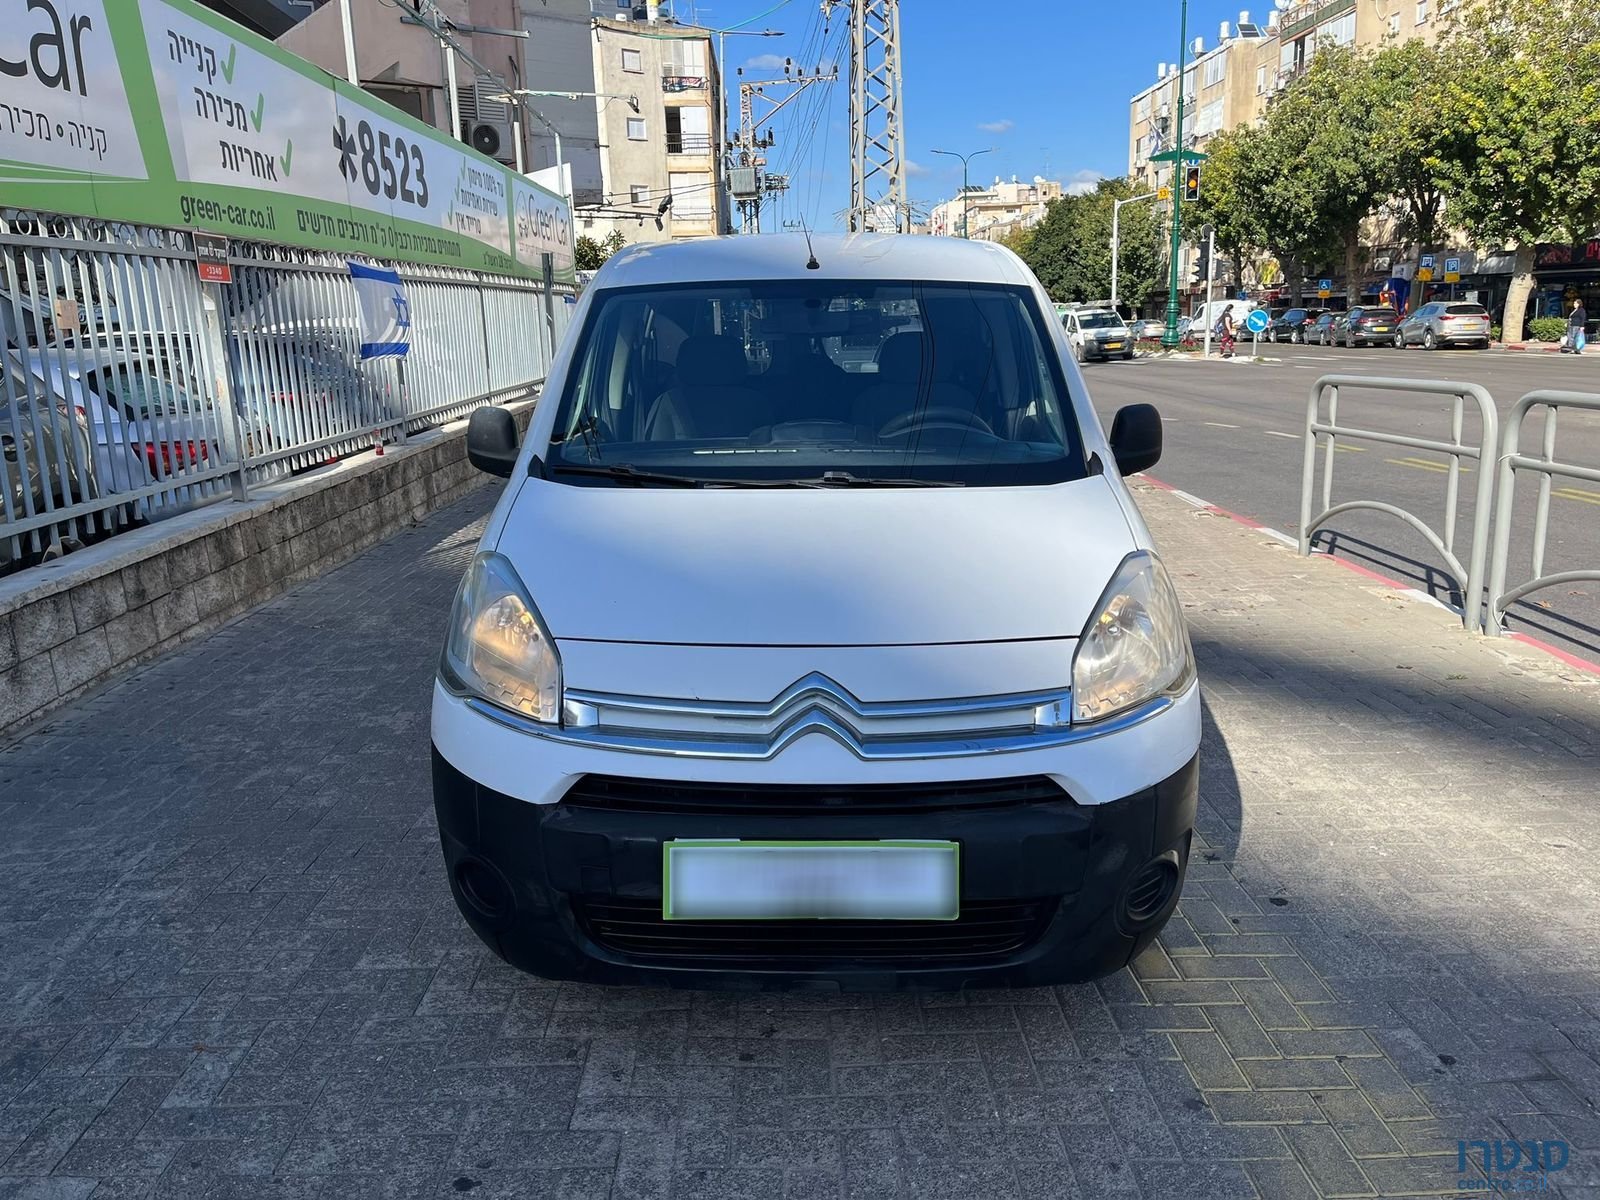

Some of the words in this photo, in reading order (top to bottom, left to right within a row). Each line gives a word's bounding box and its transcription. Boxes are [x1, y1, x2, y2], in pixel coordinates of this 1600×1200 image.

[167, 29, 217, 85] קנייה
[0, 103, 51, 141] מכיר
[194, 86, 249, 133] מכירה
[68, 120, 107, 160] קניה
[219, 140, 278, 182] אחריות
[180, 195, 276, 230] green-car.co.il
[296, 209, 336, 237] חדשים
[336, 217, 369, 243] ורכבים
[528, 193, 556, 242] Green
